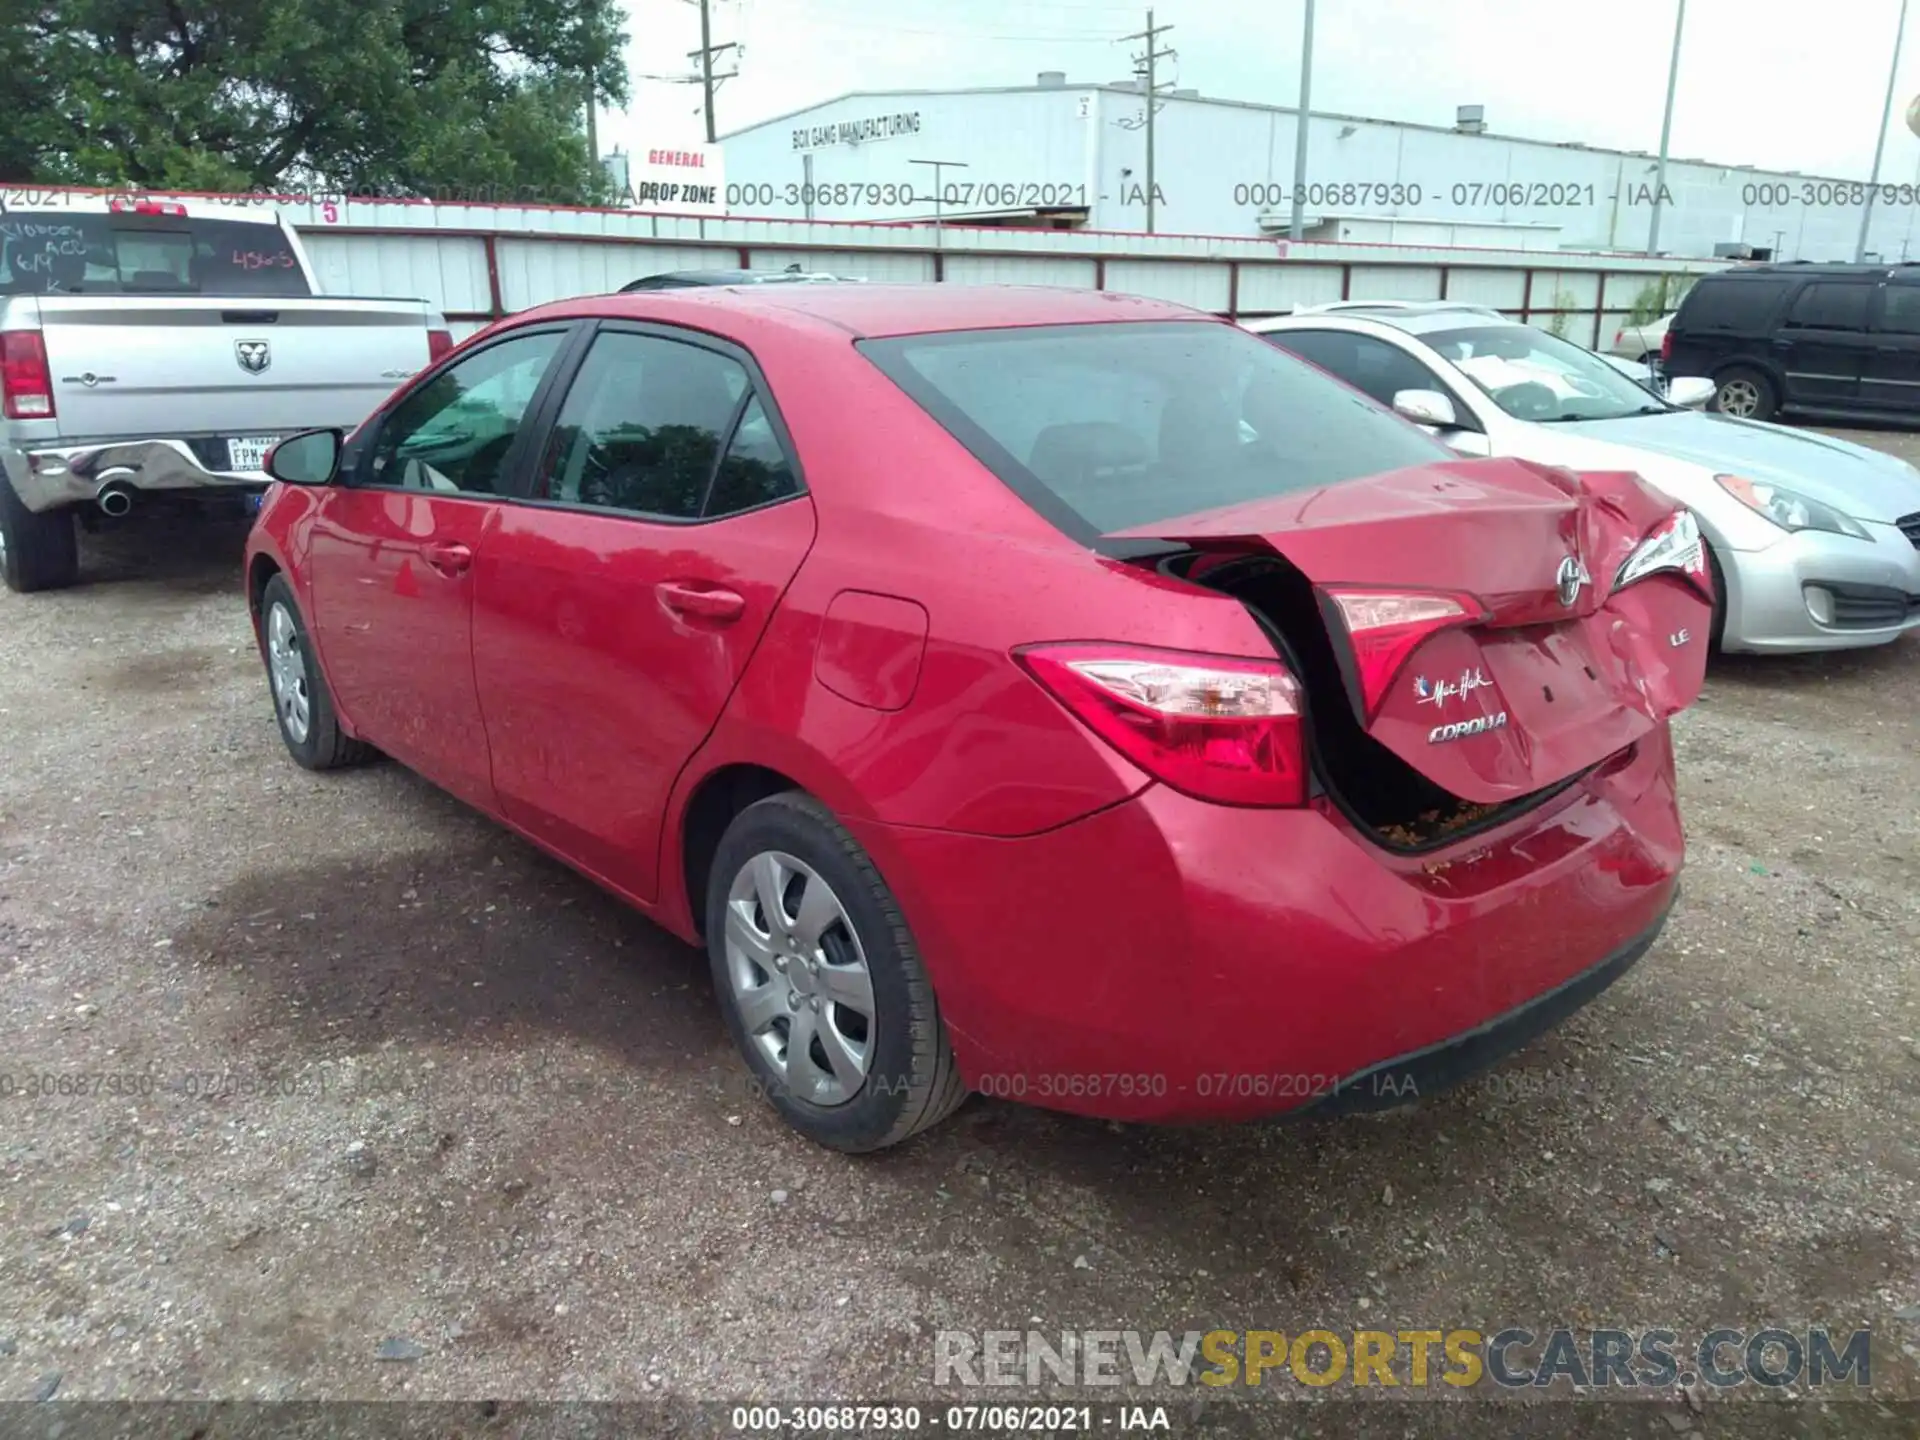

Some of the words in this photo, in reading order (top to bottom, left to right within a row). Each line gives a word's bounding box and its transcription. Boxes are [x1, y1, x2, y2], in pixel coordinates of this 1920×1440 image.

[648, 149, 705, 168] GENERAL
[640, 182, 680, 202] DROP
[681, 184, 717, 204] ZONE
[1670, 628, 1690, 647] LE
[1428, 711, 1507, 743] COROLLA
